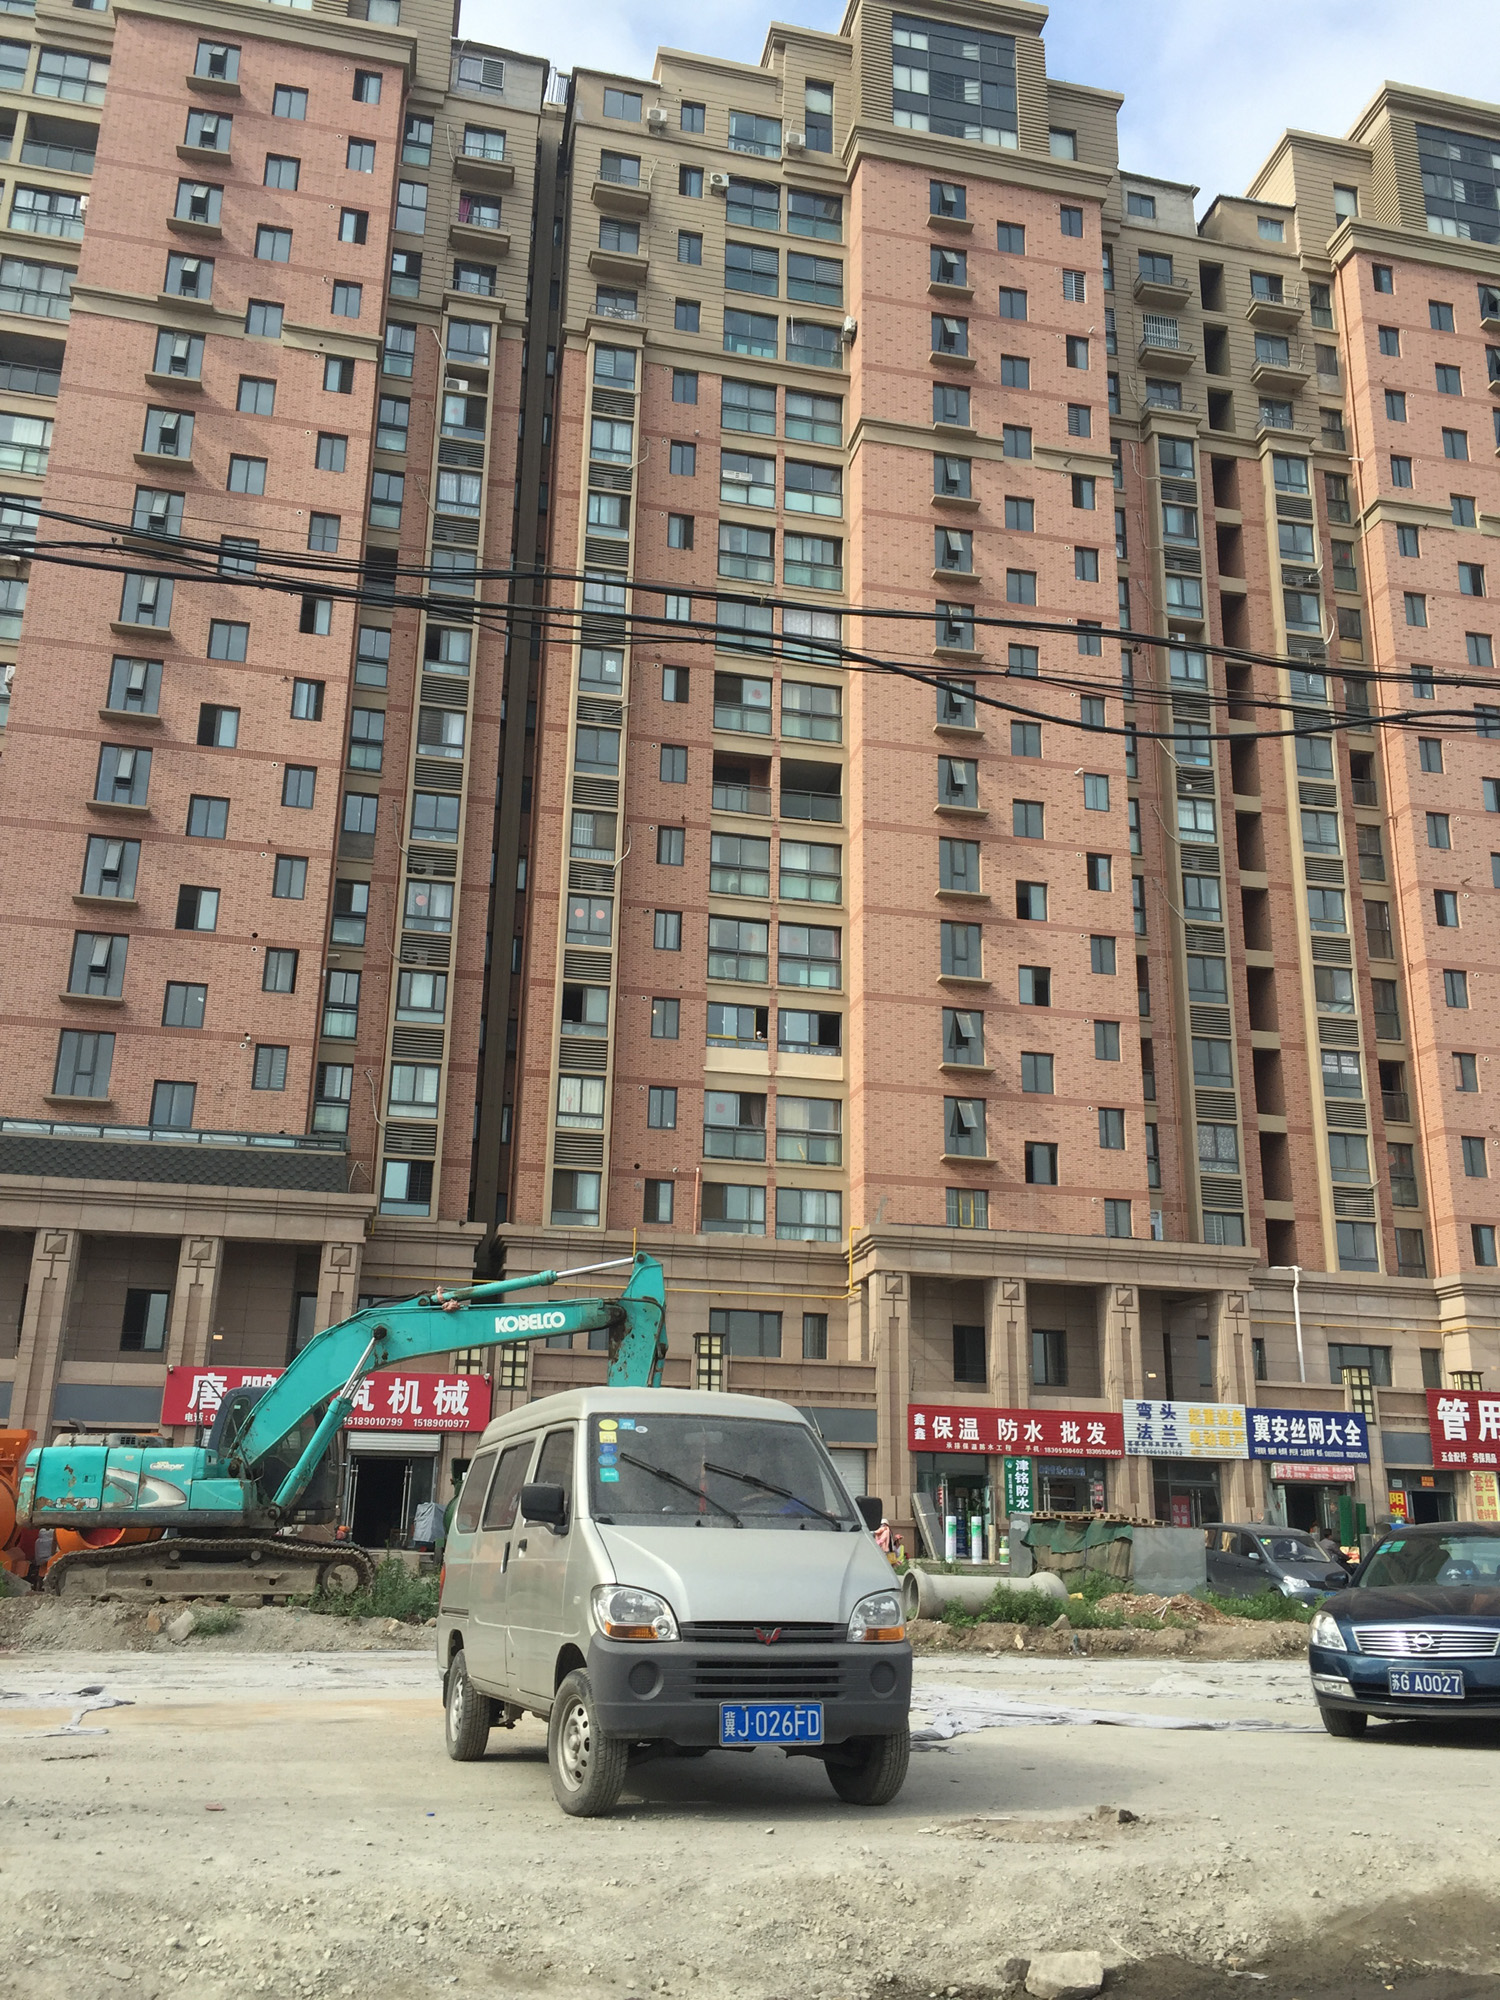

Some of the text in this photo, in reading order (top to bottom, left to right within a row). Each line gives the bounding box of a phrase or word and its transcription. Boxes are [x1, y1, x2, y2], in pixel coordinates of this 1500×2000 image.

[494, 1311, 566, 1334] KOBELCO
[413, 1418, 470, 1429] 15189010977
[1136, 1402, 1176, 1421] 弯头
[914, 1413, 926, 1441] 鑫鑫
[932, 1415, 1107, 1446] 保温 防水 批发
[1137, 1423, 1179, 1441] 法兰
[1252, 1414, 1362, 1447] 冀安丝网大全
[1014, 1459, 1030, 1509] 津铭防水
[1415, 1674, 1460, 1693] A0027
[724, 1710, 820, 1738] 冀J·026FD
